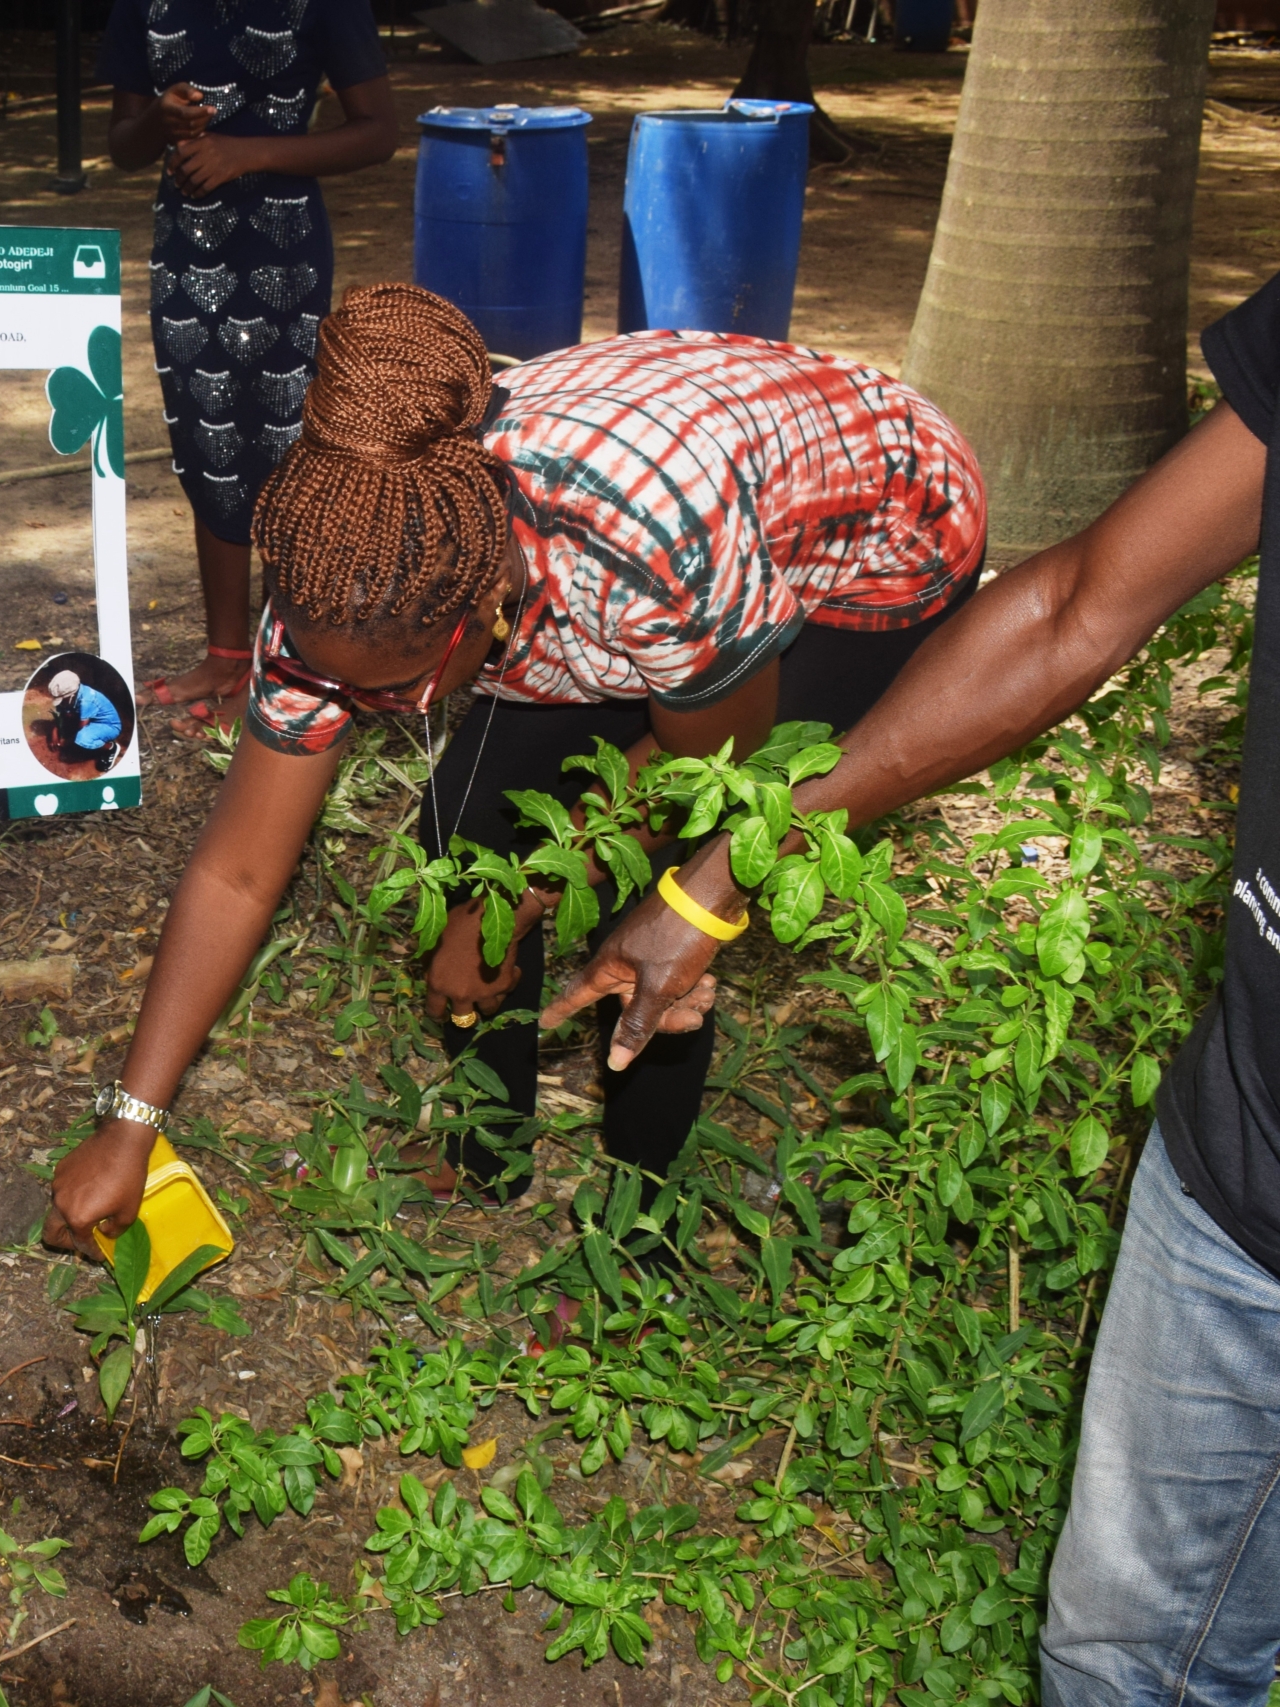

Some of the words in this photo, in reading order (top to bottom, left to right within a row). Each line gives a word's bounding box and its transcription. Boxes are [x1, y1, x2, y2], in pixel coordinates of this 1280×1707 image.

[8, 246, 54, 257] ADEDEJI
[28, 283, 47, 292] Goal
[49, 283, 59, 293] 15
[1256, 868, 1262, 881] a
[1233, 879, 1267, 936] planting
[1266, 926, 1280, 954] an
